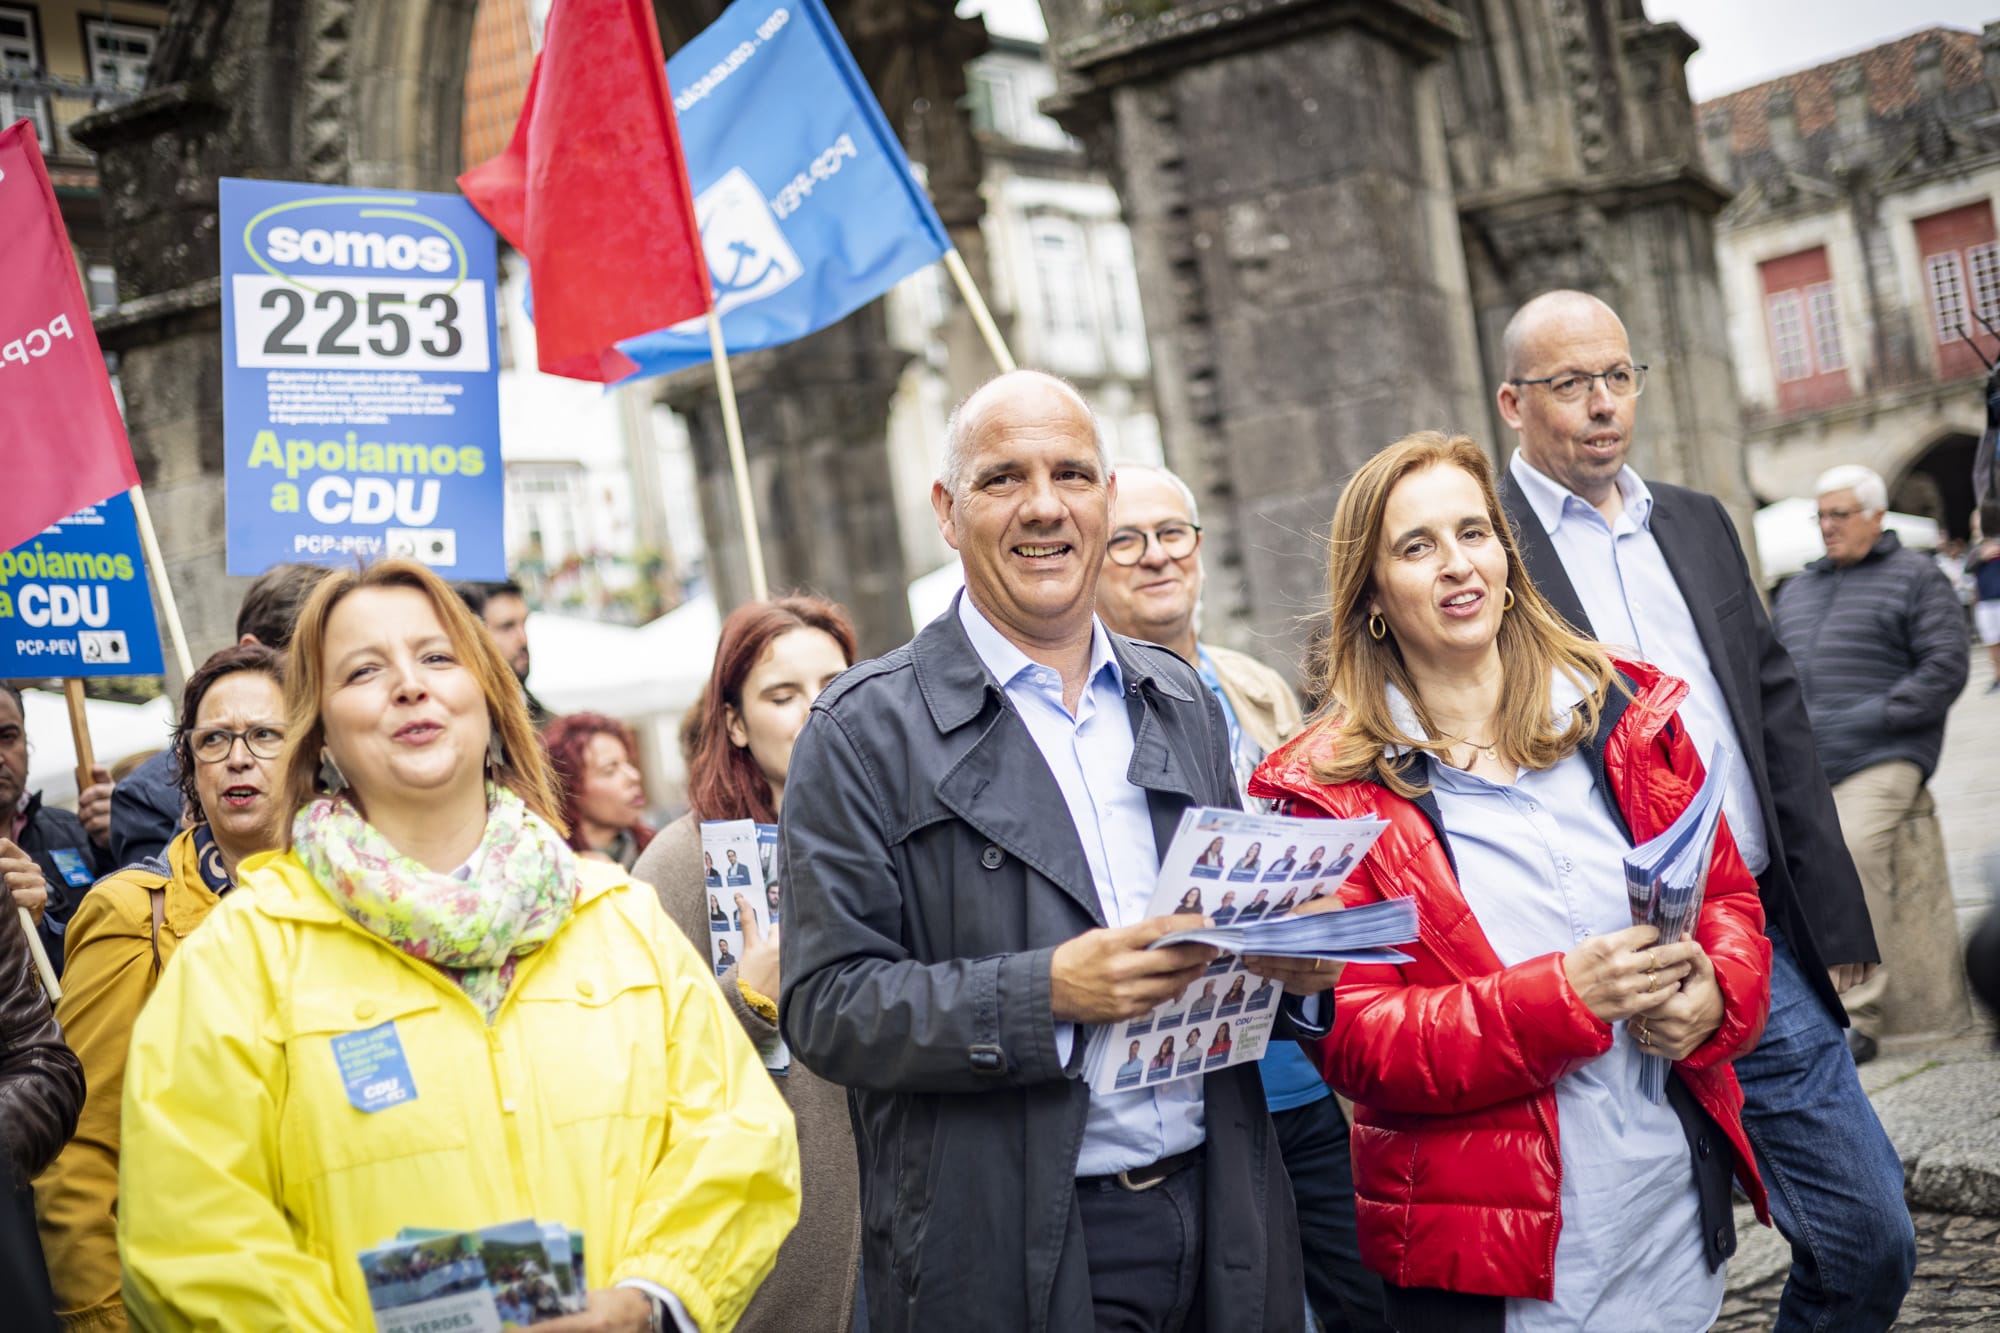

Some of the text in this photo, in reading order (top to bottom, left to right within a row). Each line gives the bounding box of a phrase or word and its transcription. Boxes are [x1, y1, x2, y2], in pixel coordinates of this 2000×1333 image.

[267, 226, 451, 273] somos
[260, 288, 462, 357] 2253
[248, 430, 485, 478] Apoiamos
[270, 475, 441, 527] a CDU
[294, 535, 382, 555] PCP-PEV
[18, 583, 110, 628] CDU
[16, 639, 77, 656] PCP-PEV
